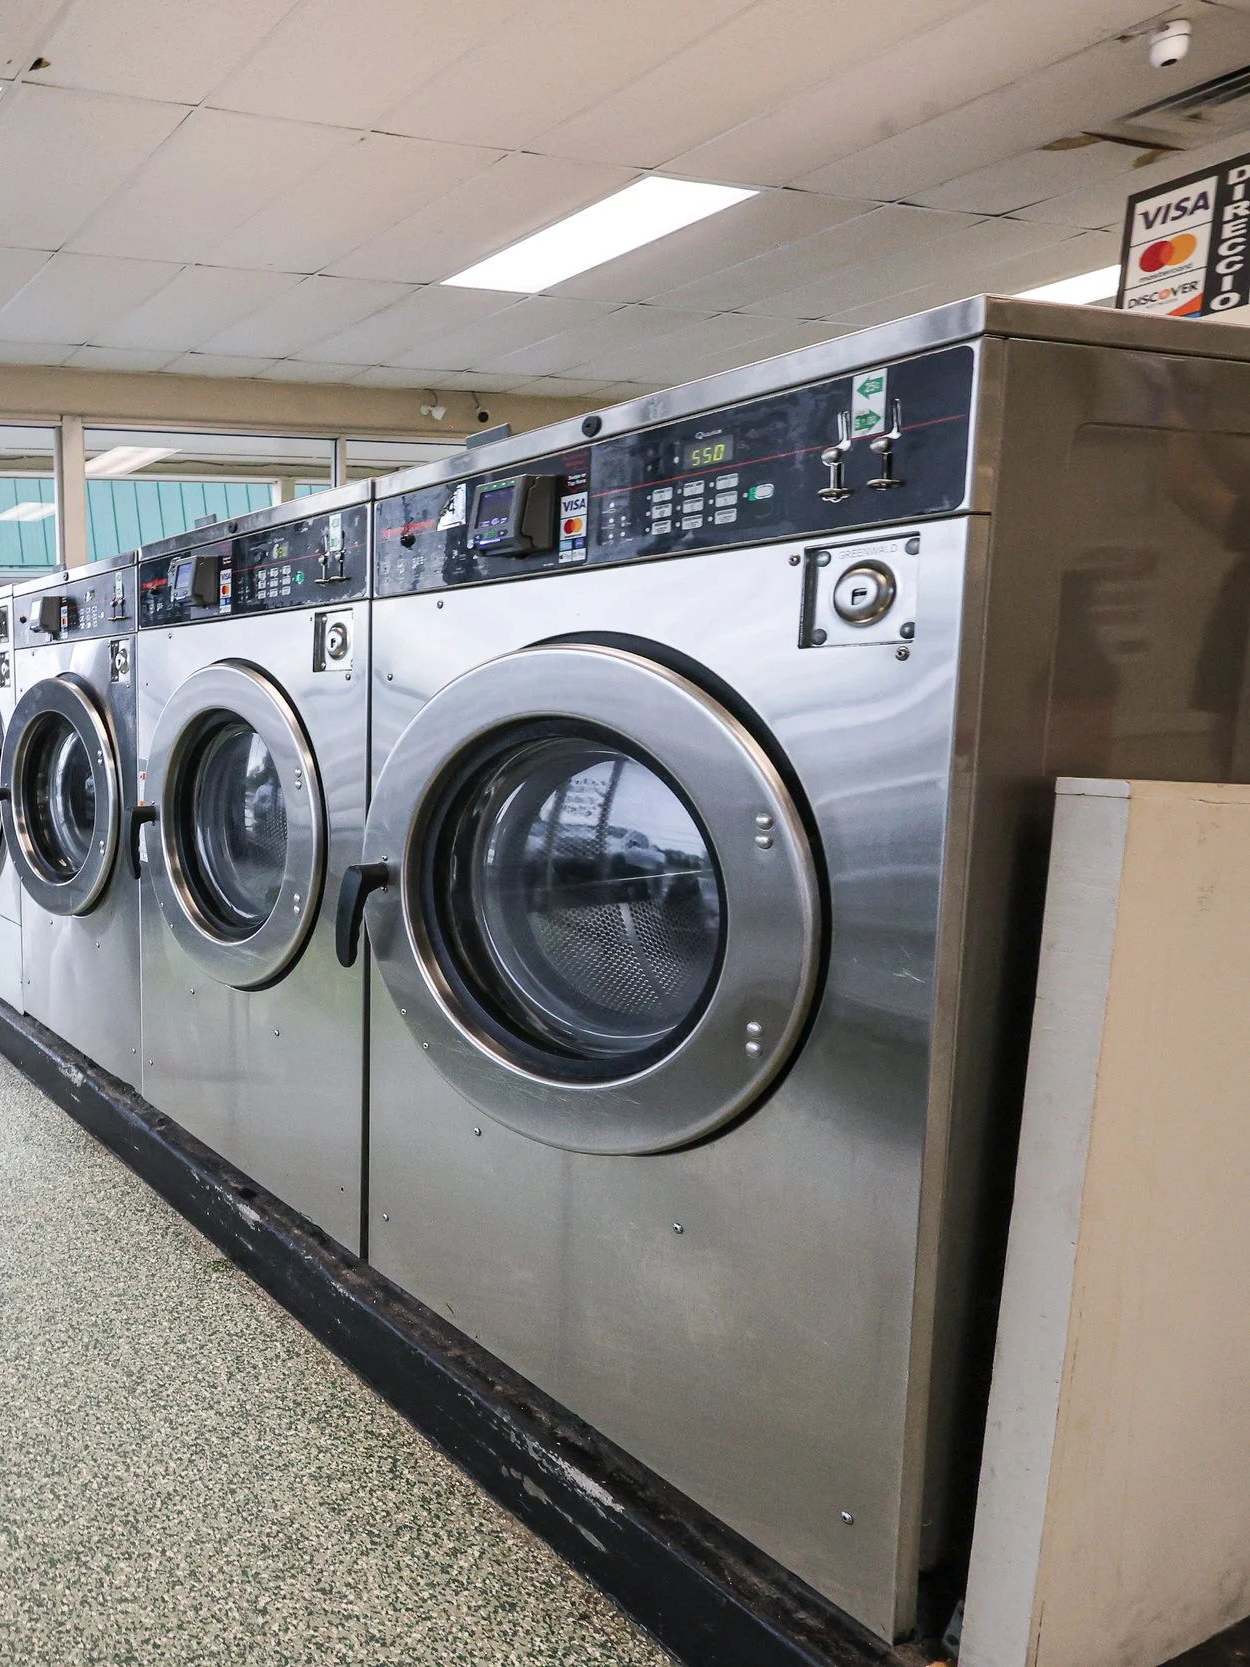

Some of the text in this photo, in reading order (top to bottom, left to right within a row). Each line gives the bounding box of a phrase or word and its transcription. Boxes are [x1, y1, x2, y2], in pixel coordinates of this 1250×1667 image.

[1138, 190, 1210, 231] VISA
[1127, 281, 1199, 309] DISCOVER
[692, 444, 726, 467] 550
[562, 498, 586, 512] VISA
